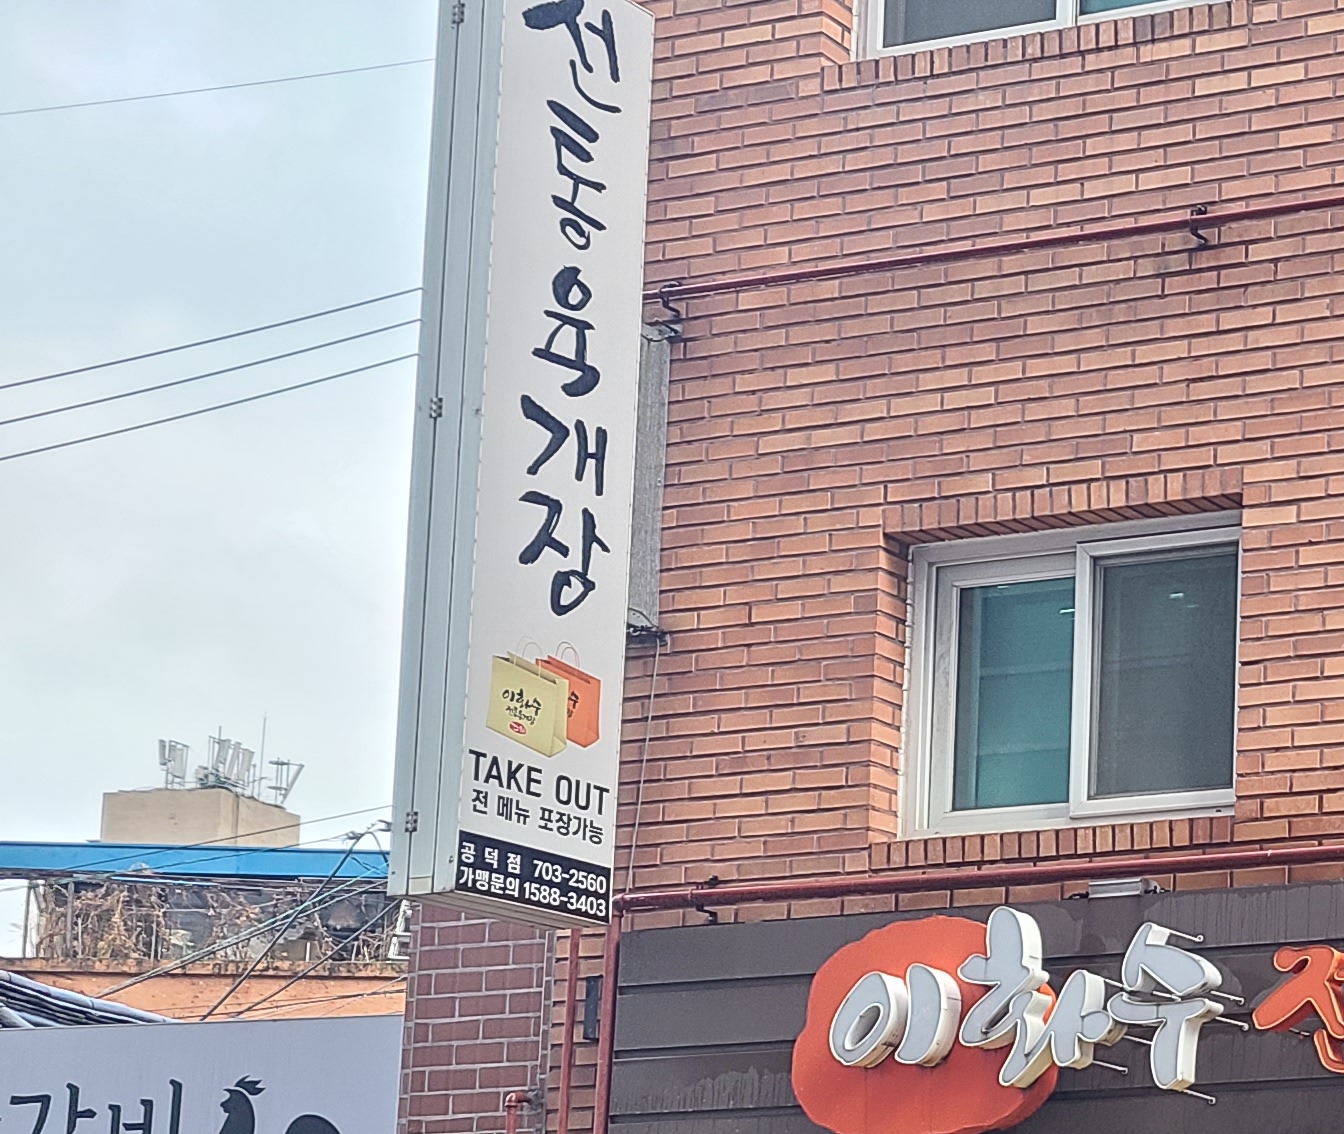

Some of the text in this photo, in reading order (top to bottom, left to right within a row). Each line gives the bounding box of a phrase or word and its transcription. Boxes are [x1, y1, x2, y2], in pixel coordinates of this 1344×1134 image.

[518, 0, 622, 616] 전통육개장
[468, 748, 611, 816] TAKE OUT
[471, 788, 604, 846] 전 메뉴 포장가능
[459, 866, 607, 917] 가맹문의 1588-3403
[532, 859, 608, 895] 703-2560
[828, 905, 1224, 1091] 이화수
